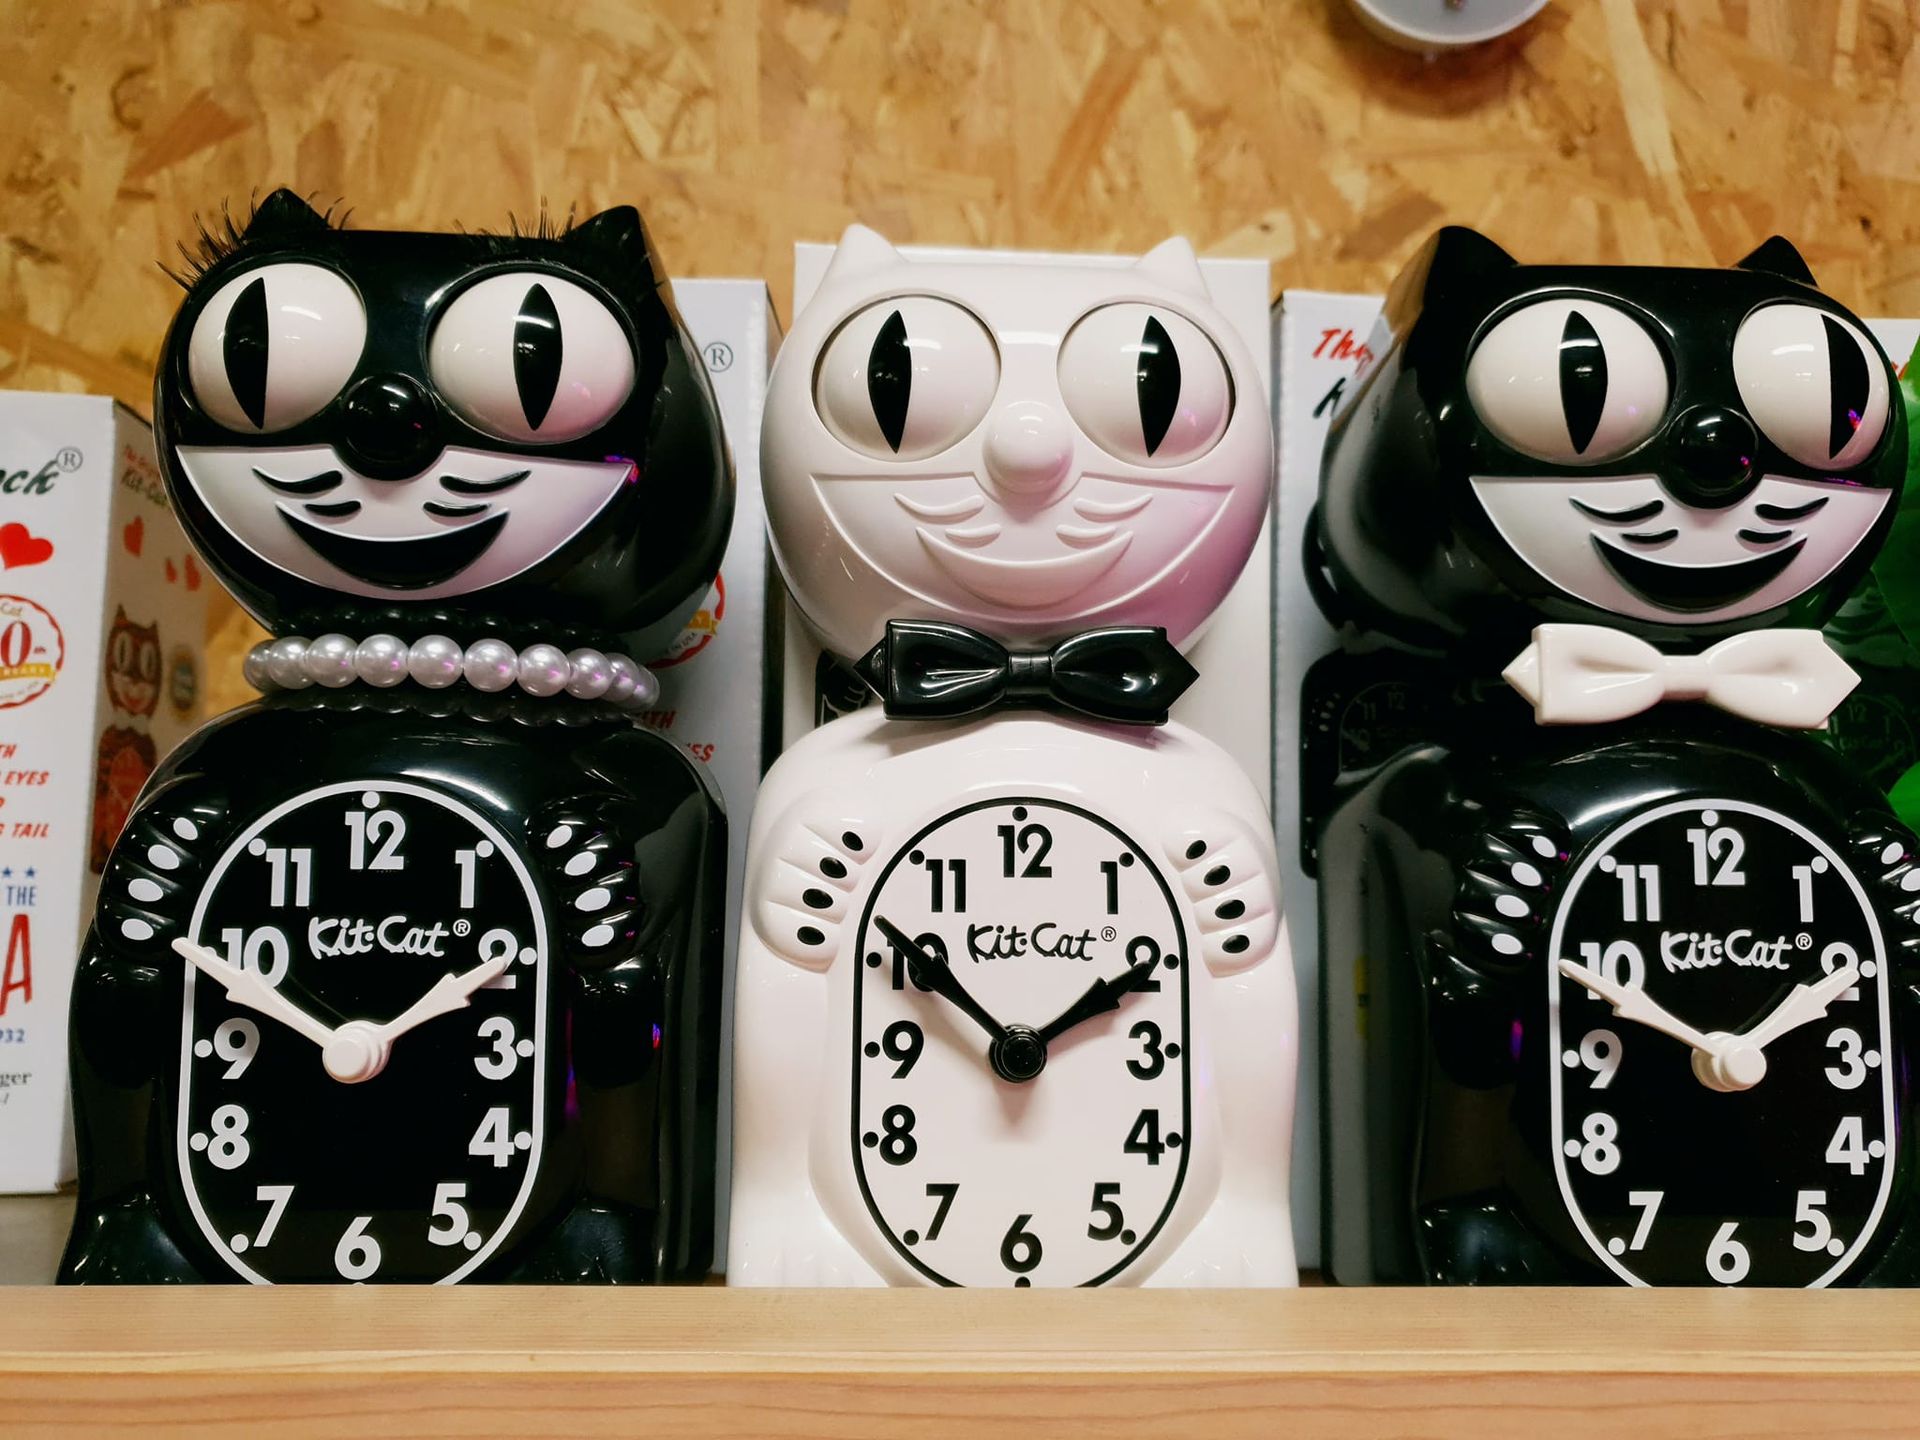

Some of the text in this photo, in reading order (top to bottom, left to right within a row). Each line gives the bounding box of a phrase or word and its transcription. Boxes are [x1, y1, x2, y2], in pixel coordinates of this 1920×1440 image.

[5, 771, 50, 786] EYES
[12, 823, 49, 838] TAIL
[345, 810, 406, 870] 12
[997, 823, 1053, 878] 12
[1687, 827, 1746, 886] 12
[7, 885, 37, 906] THE
[266, 848, 312, 907] 11
[455, 850, 476, 908] 1
[925, 858, 967, 913] 11
[1100, 861, 1119, 915] 1
[1616, 864, 1661, 922] 11
[1792, 865, 1814, 923] 1
[222, 926, 290, 989] 10
[886, 932, 949, 993] 10
[1125, 935, 1162, 993] 2
[1580, 940, 1646, 1000] 10
[213, 1017, 261, 1080] 9
[474, 1016, 518, 1080] 3
[882, 1020, 925, 1079] 9
[1126, 1020, 1165, 1081] 3
[1580, 1028, 1623, 1089] 9
[1825, 1027, 1867, 1090] 3
[207, 1104, 251, 1170] 8
[468, 1107, 516, 1168] 4
[879, 1104, 918, 1166] 8
[1123, 1109, 1166, 1166] 4
[1580, 1112, 1621, 1176] 8
[1825, 1116, 1870, 1176] 4
[253, 1185, 296, 1248] 7
[428, 1183, 470, 1246] 5
[925, 1183, 961, 1241] 7
[1087, 1182, 1124, 1241] 5
[1629, 1191, 1665, 1251] 7
[1793, 1190, 1832, 1252] 5
[334, 1216, 382, 1281] 6
[1000, 1214, 1043, 1274] 6
[1706, 1222, 1751, 1285] 6
